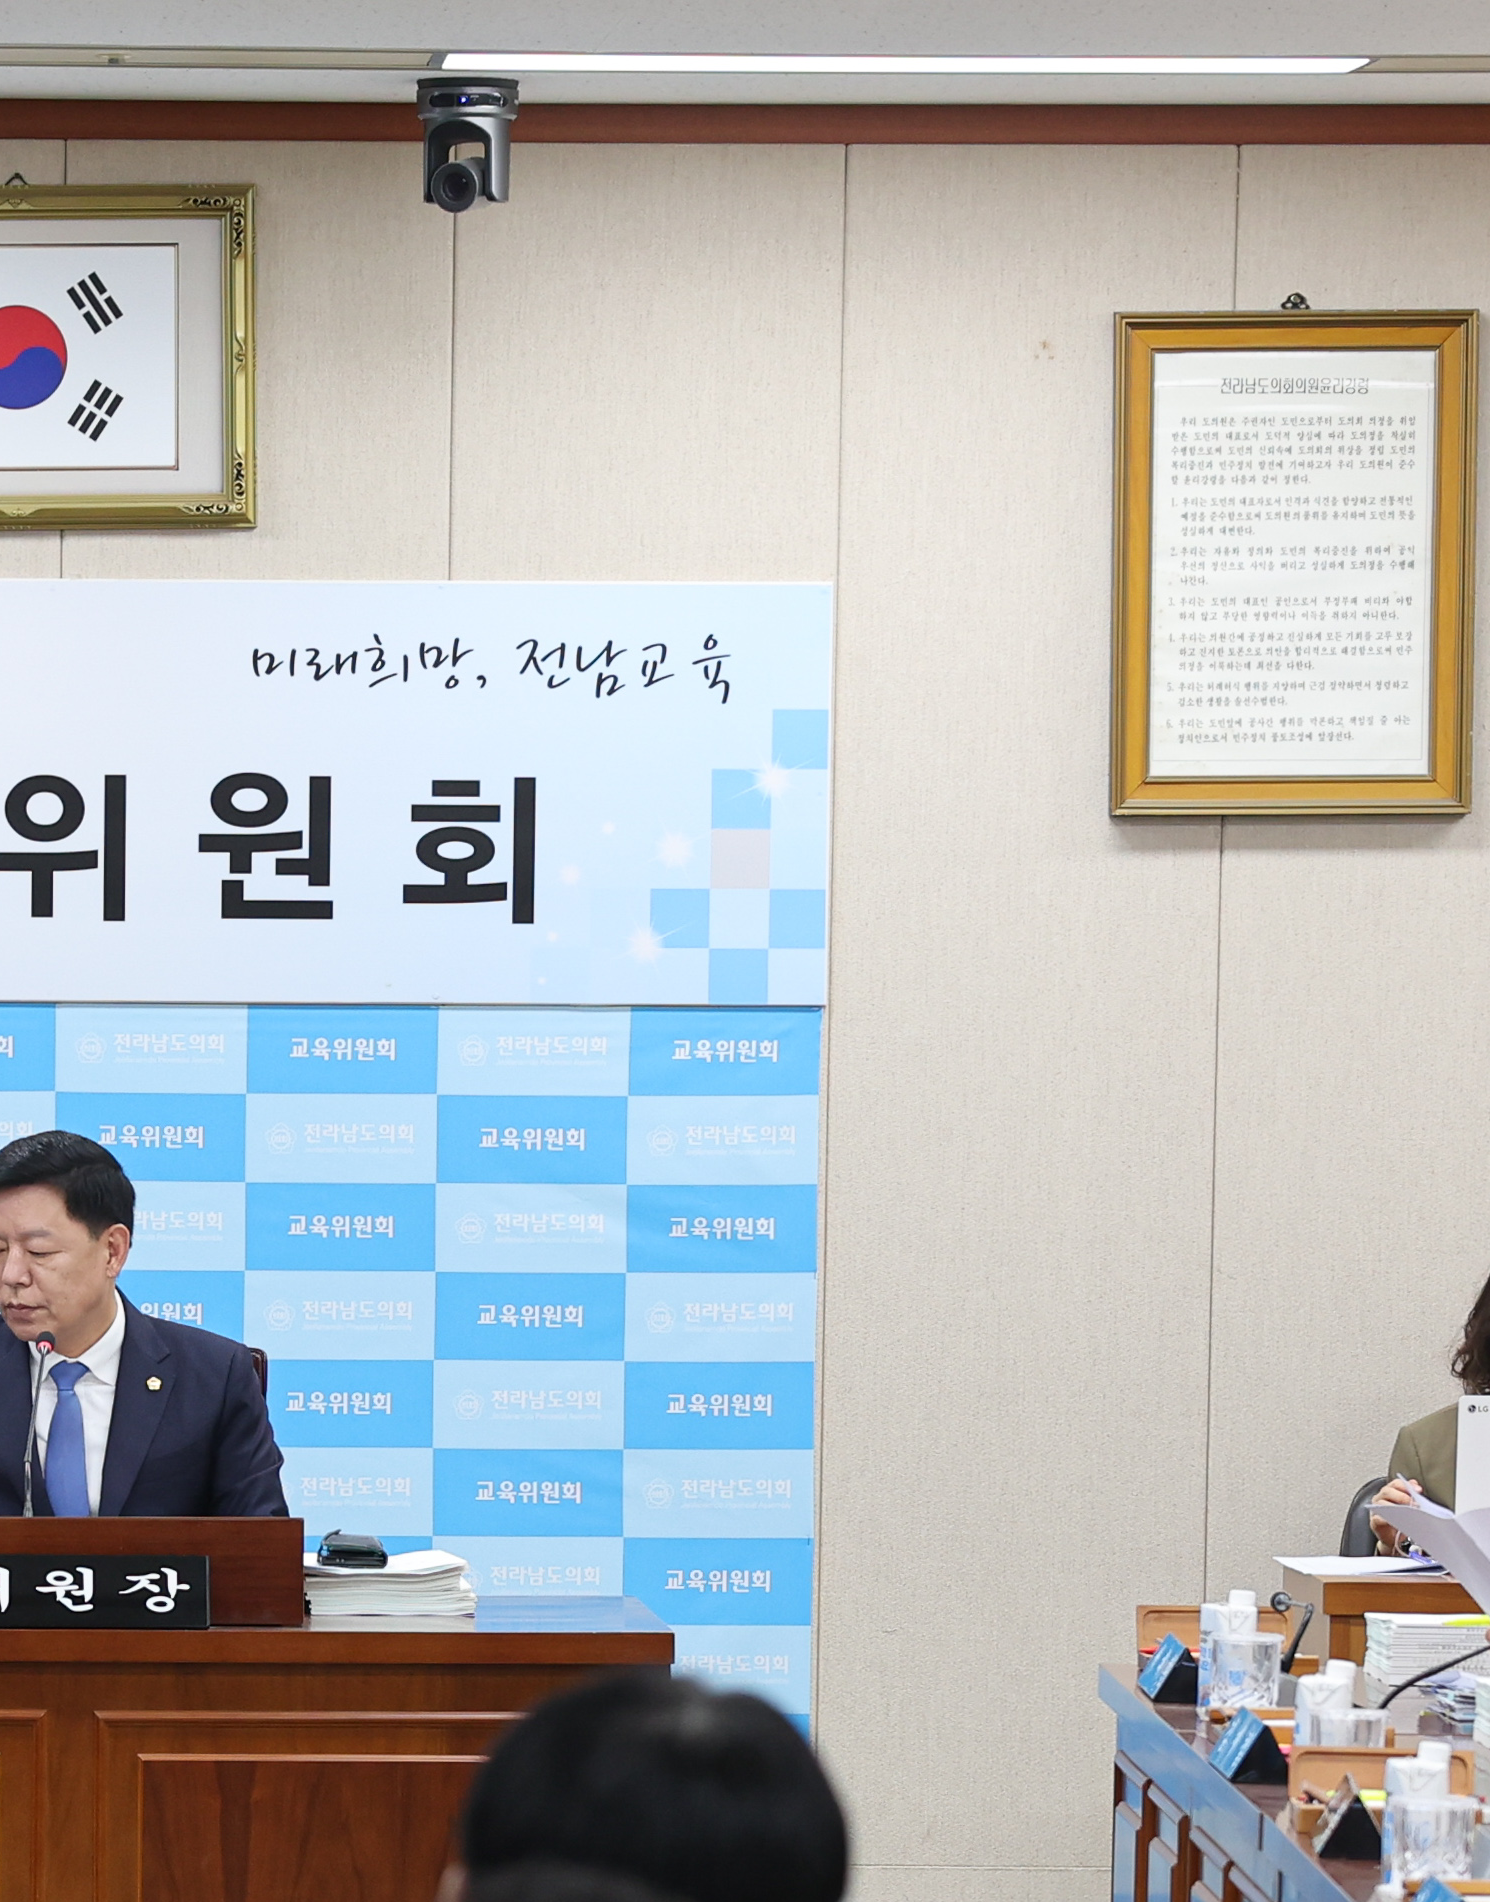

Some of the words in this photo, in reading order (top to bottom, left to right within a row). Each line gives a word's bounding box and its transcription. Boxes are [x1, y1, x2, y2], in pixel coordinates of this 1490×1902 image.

[1220, 378, 1369, 395] 전라남도의회의원윤리강령
[253, 634, 486, 689] 미래희망,
[115, 1034, 224, 1053] 전라남도의회
[290, 1038, 395, 1060] 교육위원회
[497, 1036, 607, 1055] 전라남도의회
[672, 1040, 778, 1062] 교육위원회
[98, 1125, 204, 1148] 교육위원회
[305, 1124, 414, 1143] 전라남도의회
[480, 1128, 585, 1150] 교육위원회
[686, 1126, 796, 1145] 전라남도의회
[135, 1212, 222, 1231] 라남도의회
[288, 1215, 394, 1238] 교육위원회
[495, 1214, 604, 1233] 전라남도의회
[669, 1218, 775, 1240] 교육위원회
[140, 1303, 202, 1325] 위원회
[303, 1301, 412, 1320] 전라남도의회
[478, 1305, 583, 1327] 교육위원회
[685, 1303, 794, 1322] 전라남도의회
[286, 1392, 391, 1414] 교육위원회
[493, 1390, 602, 1410] 전라남도의회
[667, 1394, 772, 1416] 교육위원회
[1478, 1405, 1489, 1413] LG
[301, 1478, 411, 1496] 전라남도의회
[476, 1481, 581, 1503] 교육위원회
[682, 1480, 791, 1499] 전라남도의회
[492, 1567, 600, 1585] 전라남도의회
[665, 1570, 771, 1593] 교육위원회
